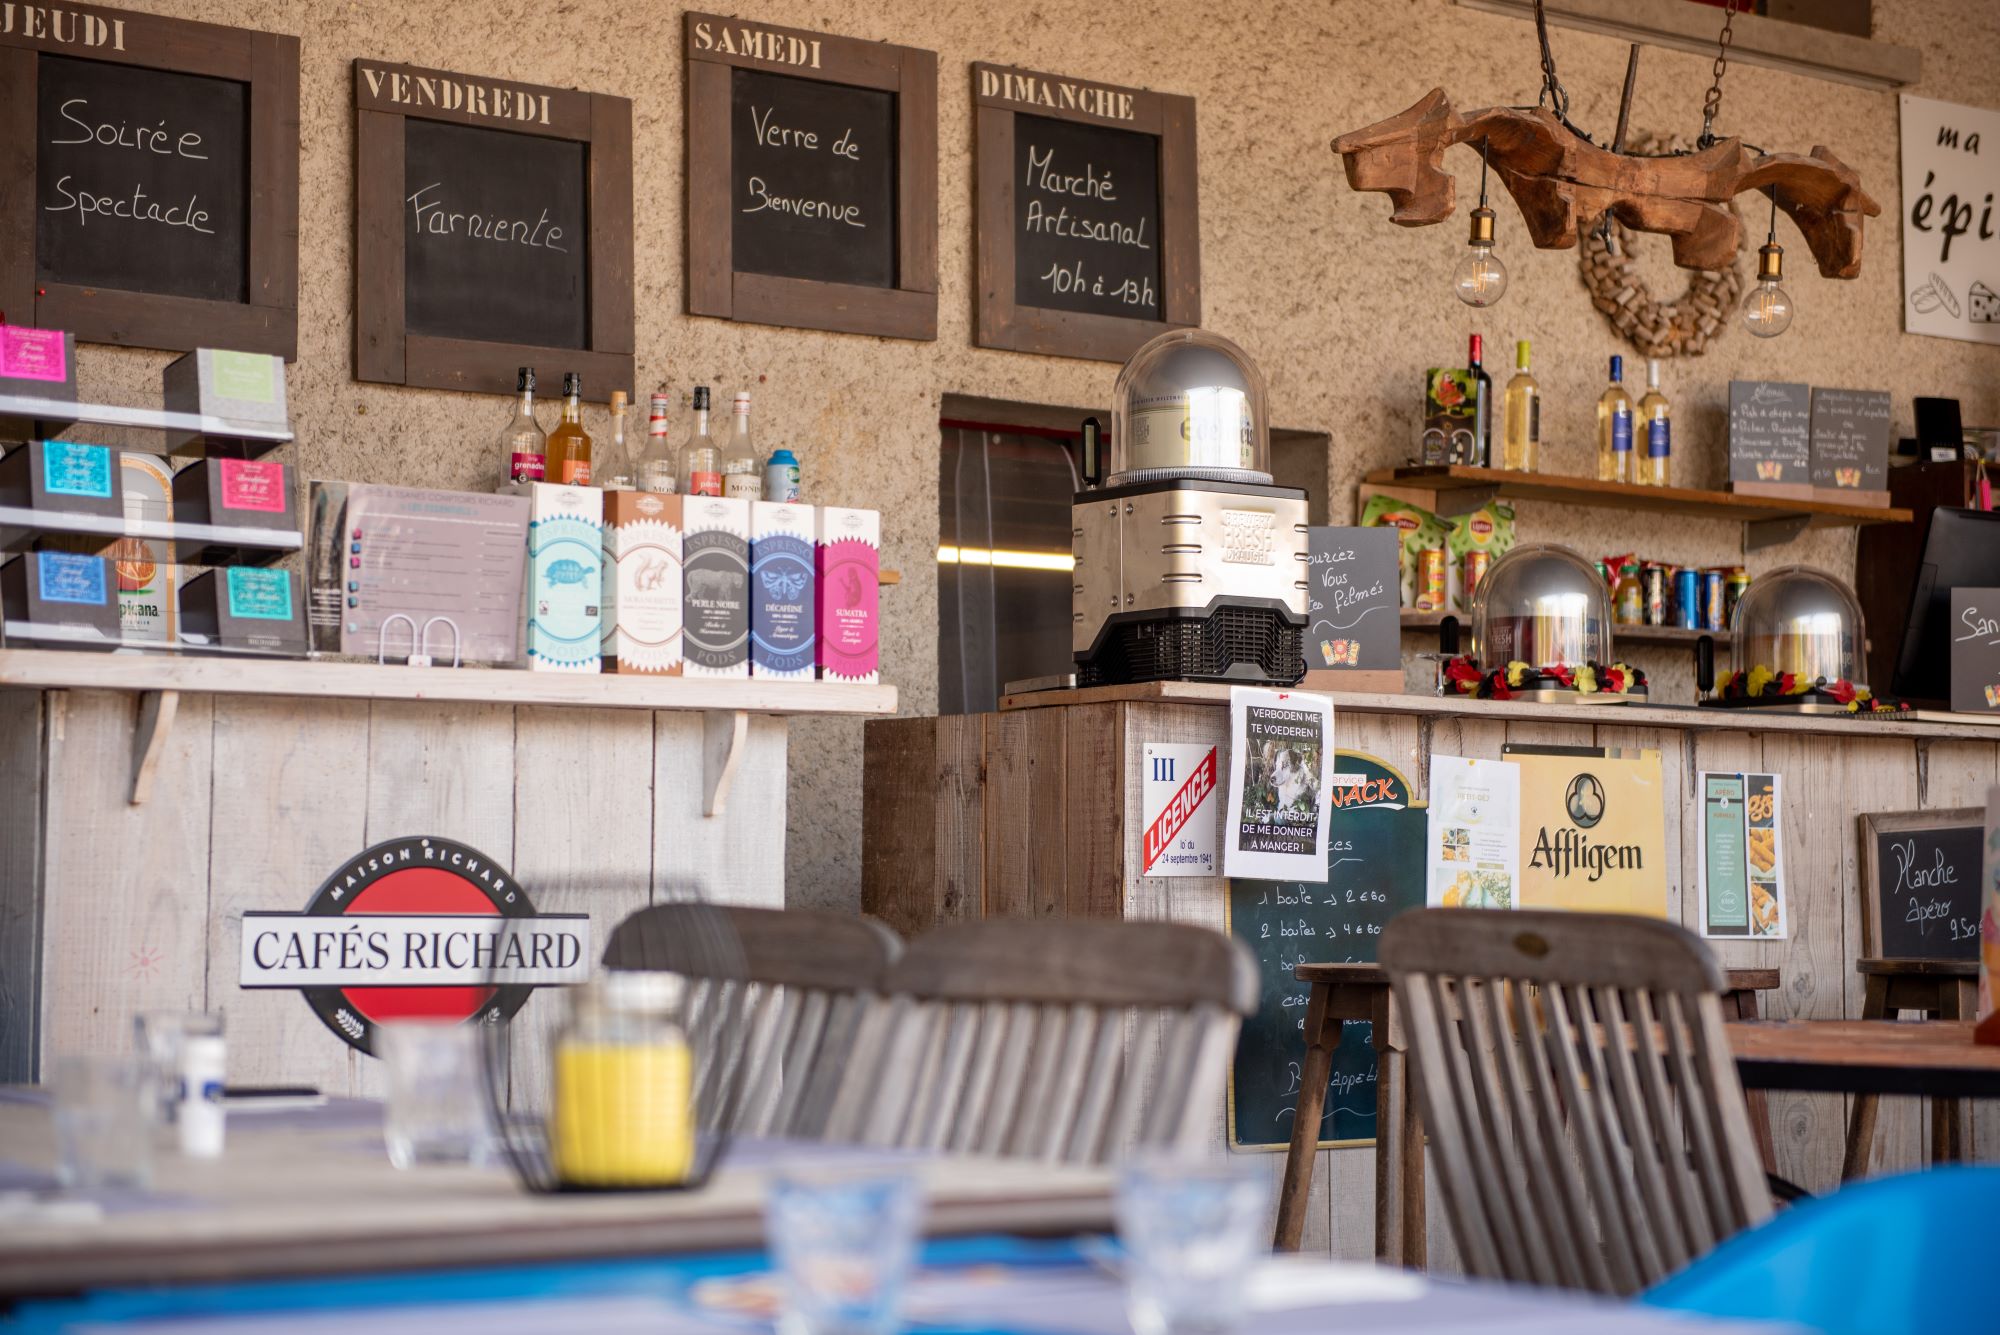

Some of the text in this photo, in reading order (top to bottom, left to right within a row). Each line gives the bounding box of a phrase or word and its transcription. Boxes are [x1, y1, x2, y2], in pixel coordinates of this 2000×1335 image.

[0, 3, 126, 51] JEUDI
[695, 23, 822, 69] SAMEDI
[361, 68, 552, 125] VENDREDI
[981, 70, 1134, 120] DIMANCHE
[52, 99, 208, 160] Soirée
[751, 106, 859, 160] Verre de
[1936, 125, 1980, 155] ma
[1027, 145, 1116, 201] Marché
[45, 175, 215, 234] Spectacle
[742, 177, 865, 227] Bienvenue
[407, 183, 568, 252] Farniente
[1027, 200, 1150, 248] Artisanal
[1911, 170, 1998, 263] épi
[1041, 261, 1155, 306] 10h à 13h
[514, 461, 545, 470] grenadin
[653, 486, 675, 494] MON
[1472, 522, 1492, 533] Lipton
[687, 532, 746, 553] ESPRESSO
[756, 538, 813, 559] ESPRESSO
[1306, 546, 1355, 566] ouriez
[1322, 567, 1348, 588] Vous
[119, 600, 157, 619] picana
[691, 599, 741, 610] PERLE NOIRE
[1308, 579, 1384, 615] tes filmés
[836, 608, 868, 618] SUMATRA
[1954, 607, 1999, 642] San
[696, 651, 737, 665] PODS
[766, 654, 804, 668] PODS
[1252, 707, 1303, 721] VERBODEN
[1251, 723, 1262, 733] TE
[1264, 725, 1314, 738] VOEDEREN
[1153, 757, 1176, 781] III
[1333, 775, 1364, 784] ervice
[1332, 777, 1398, 808] NACK
[1150, 759, 1210, 861] LICENCE
[1246, 808, 1315, 822] IL EST INTERDIT
[1242, 824, 1313, 837] DE ME DONNER
[1188, 840, 1195, 850] du
[1260, 841, 1300, 852] MANGER
[1528, 826, 1644, 882] Affligem
[1162, 854, 1212, 866] 24 septembre 1941
[1891, 839, 1958, 895] Planche
[330, 847, 516, 905] MAISON RICHARD
[1277, 884, 1313, 905] boule
[1261, 923, 1271, 938] 2
[1281, 919, 1315, 937] boules
[253, 925, 581, 970] CAFÉS RICHARD
[1331, 1064, 1378, 1095] appéti
